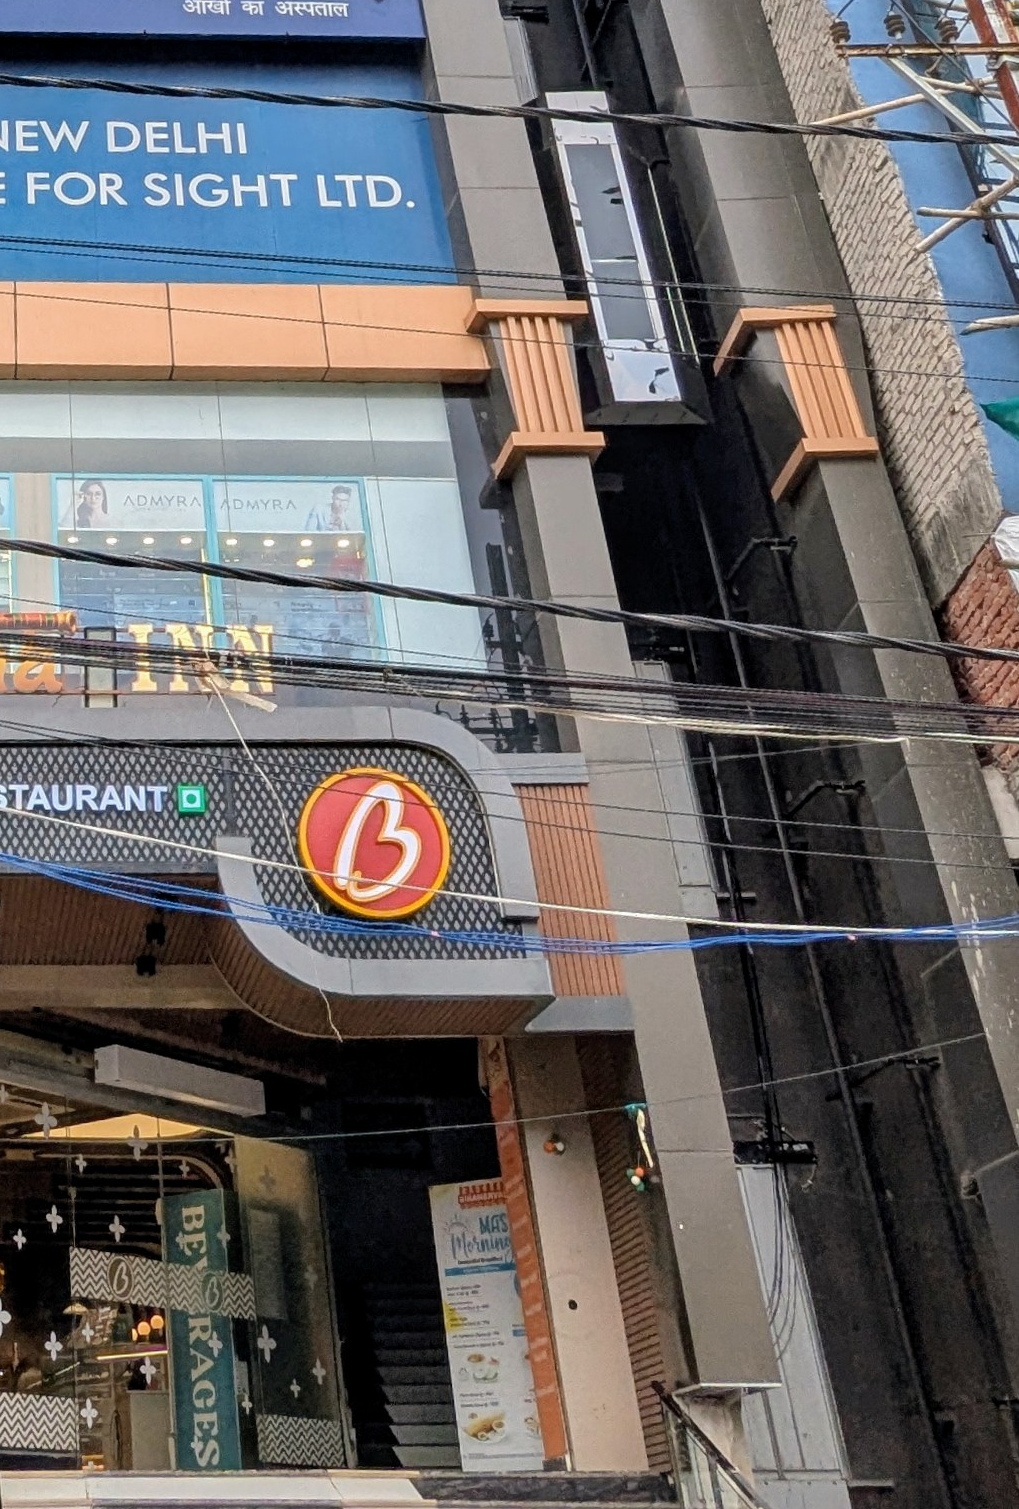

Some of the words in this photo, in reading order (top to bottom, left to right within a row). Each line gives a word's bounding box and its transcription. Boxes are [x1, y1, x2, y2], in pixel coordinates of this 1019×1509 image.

[241, 0, 265, 16] का
[276, 0, 348, 18] अस्पताल
[106, 120, 247, 155] DELHI
[27, 171, 128, 206] FOR
[145, 172, 298, 208] SIGHT
[316, 174, 416, 209] LTD.
[123, 495, 201, 508] ADMYRA
[220, 498, 298, 511] ADMYRA
[128, 623, 274, 692] INN
[182, 1204, 220, 1468] BERAGES
